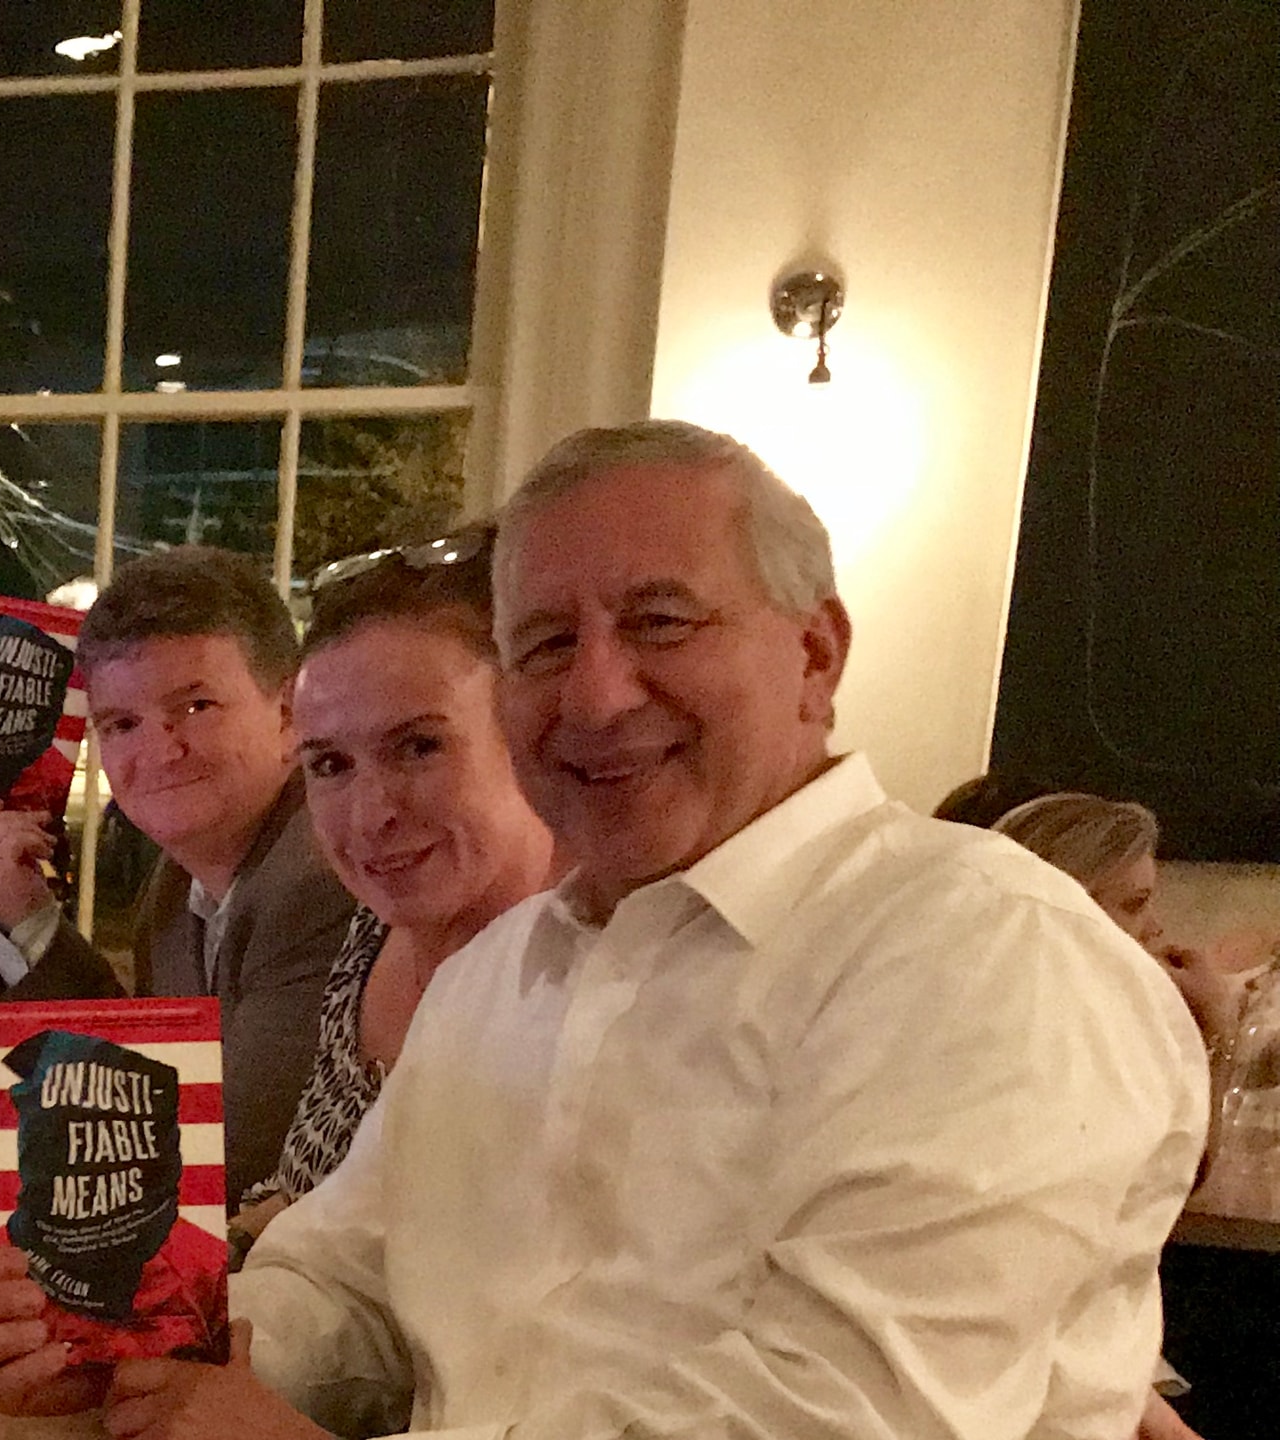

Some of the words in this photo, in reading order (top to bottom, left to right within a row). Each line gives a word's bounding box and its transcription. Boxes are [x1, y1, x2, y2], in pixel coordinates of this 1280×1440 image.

[40, 1061, 164, 1115] UNJUSTI-
[67, 1120, 160, 1165] FIABLE
[49, 1166, 143, 1221] MEANS
